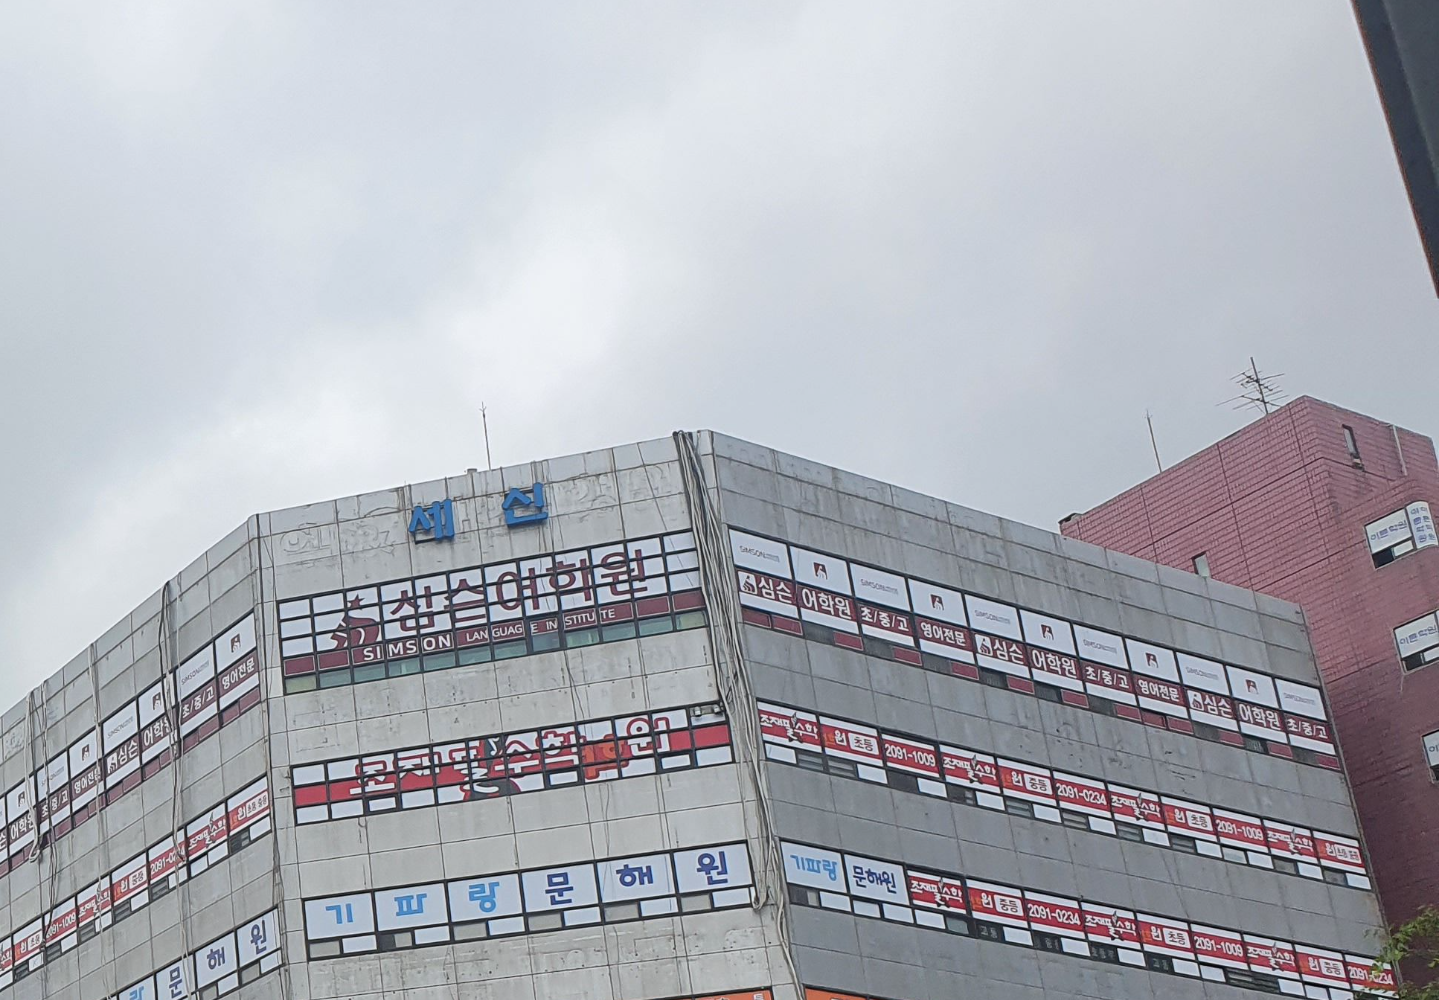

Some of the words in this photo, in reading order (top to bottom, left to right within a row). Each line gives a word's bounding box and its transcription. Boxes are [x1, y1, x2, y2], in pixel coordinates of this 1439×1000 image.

[390, 548, 648, 631] 심슨어학원
[759, 577, 794, 604] 심슨
[802, 588, 852, 620] 어학원
[861, 606, 910, 633] 초/중/고
[363, 633, 451, 664] SIMSON
[465, 621, 524, 644] LANGUAGE
[545, 607, 616, 630] INSTITUTE
[920, 621, 966, 647] 영어전문
[993, 641, 1024, 665] 심슨
[1032, 652, 1077, 678] 어학원
[221, 657, 255, 690] 영어전문
[1085, 665, 1130, 690] 초/중/고
[181, 686, 215, 719] 초/중/고
[1138, 678, 1180, 702] 영어전문
[1203, 694, 1231, 717] 심슨
[1239, 704, 1281, 731] 어학원
[1287, 716, 1328, 740] 초/중/고
[117, 739, 139, 765] 심슨
[885, 743, 936, 768] 2091-1009
[1027, 775, 1048, 792] 중등
[1056, 782, 1107, 806] 2091-0234
[1216, 818, 1263, 841] 2091-1009
[790, 854, 837, 881] 기파랑
[852, 864, 897, 894] 문해원
[325, 880, 501, 925] 기파랑
[544, 850, 730, 906] 문해원
[999, 897, 1019, 913] 중등
[1028, 903, 1081, 926] 2091-0234
[169, 919, 267, 998] 문해원
[1193, 936, 1244, 957] 2091-1009
